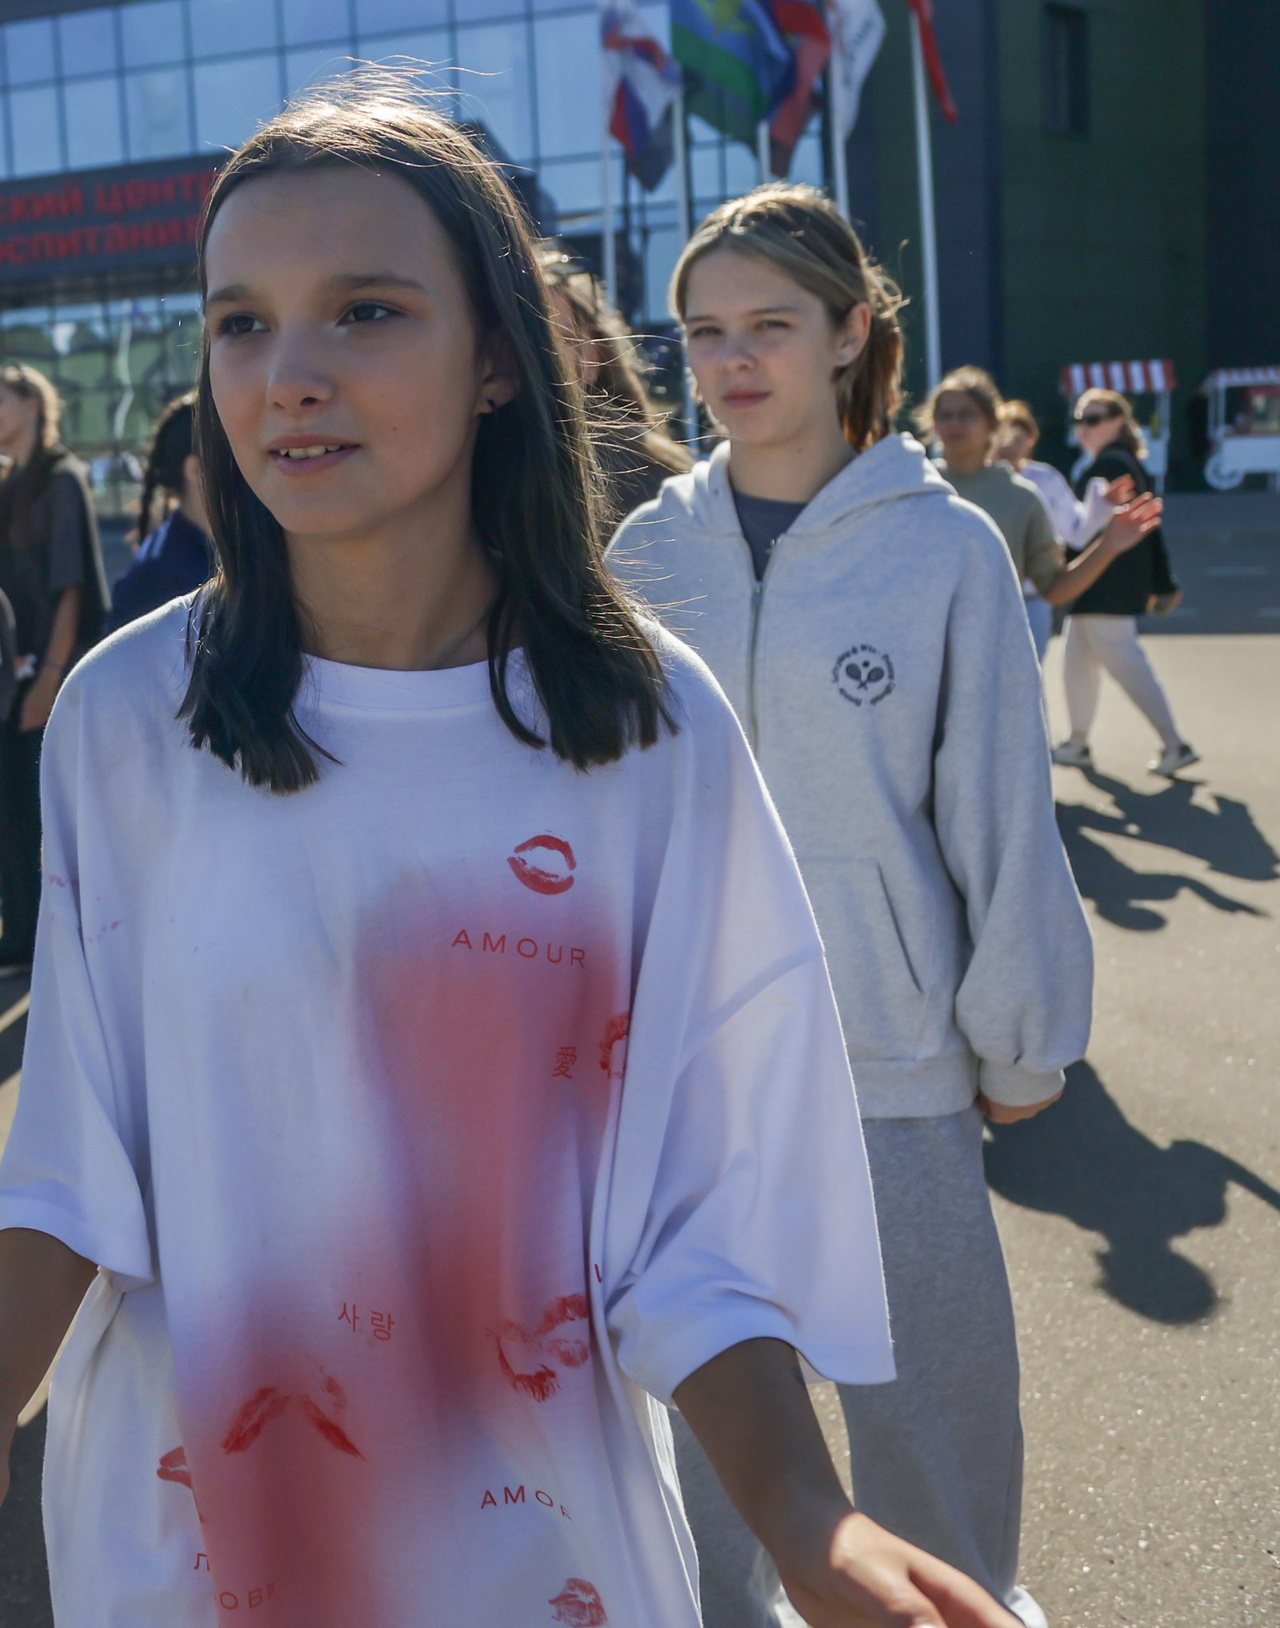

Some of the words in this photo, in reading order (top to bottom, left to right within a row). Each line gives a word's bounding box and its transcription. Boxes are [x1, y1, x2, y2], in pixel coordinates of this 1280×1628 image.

[451, 929, 586, 969] AMOUR
[552, 1046, 577, 1080] 愛
[337, 1302, 396, 1342] 사랑
